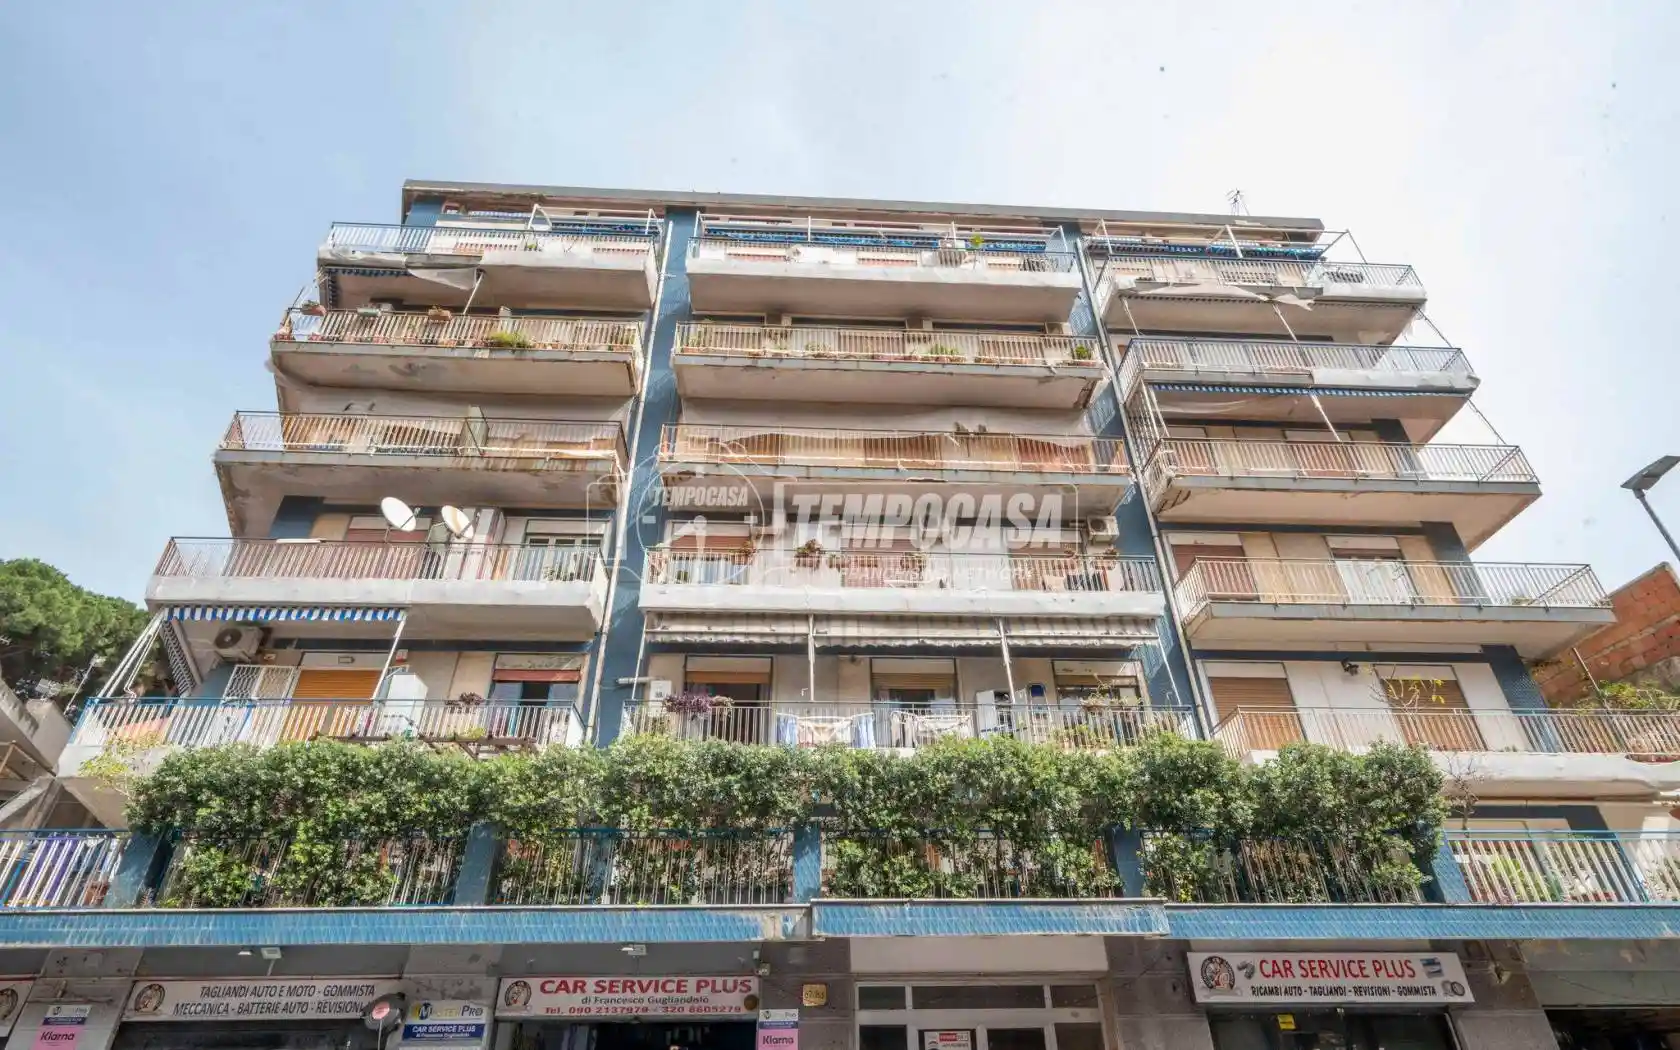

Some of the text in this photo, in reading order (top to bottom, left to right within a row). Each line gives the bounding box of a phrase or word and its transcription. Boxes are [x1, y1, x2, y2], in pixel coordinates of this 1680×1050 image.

[1259, 959, 1416, 979] CAR SERVICE PLUS
[200, 985, 249, 998] TAGLIANDI
[250, 985, 278, 998] AUTO
[278, 985, 287, 997] E
[286, 984, 316, 997] MOTO
[323, 985, 375, 997] GOMMISTA
[540, 979, 752, 994] CAR SERVICE PLUS
[1251, 985, 1282, 996] RICAMBI
[1284, 985, 1302, 996] AUTO
[1309, 985, 1347, 996] TAGLIANDI
[1354, 985, 1391, 996] REVISIONI
[1397, 985, 1437, 996] GOMMISTA
[581, 996, 591, 1004] di
[594, 996, 644, 1004] Francesco
[173, 1002, 230, 1016] MECCANICA
[237, 1002, 281, 1014] BATTERIE
[282, 1002, 309, 1014] AUTO
[428, 1025, 456, 1033] SERVICE
[40, 1031, 75, 1041] Klarna
[763, 1035, 794, 1045] Klarna
